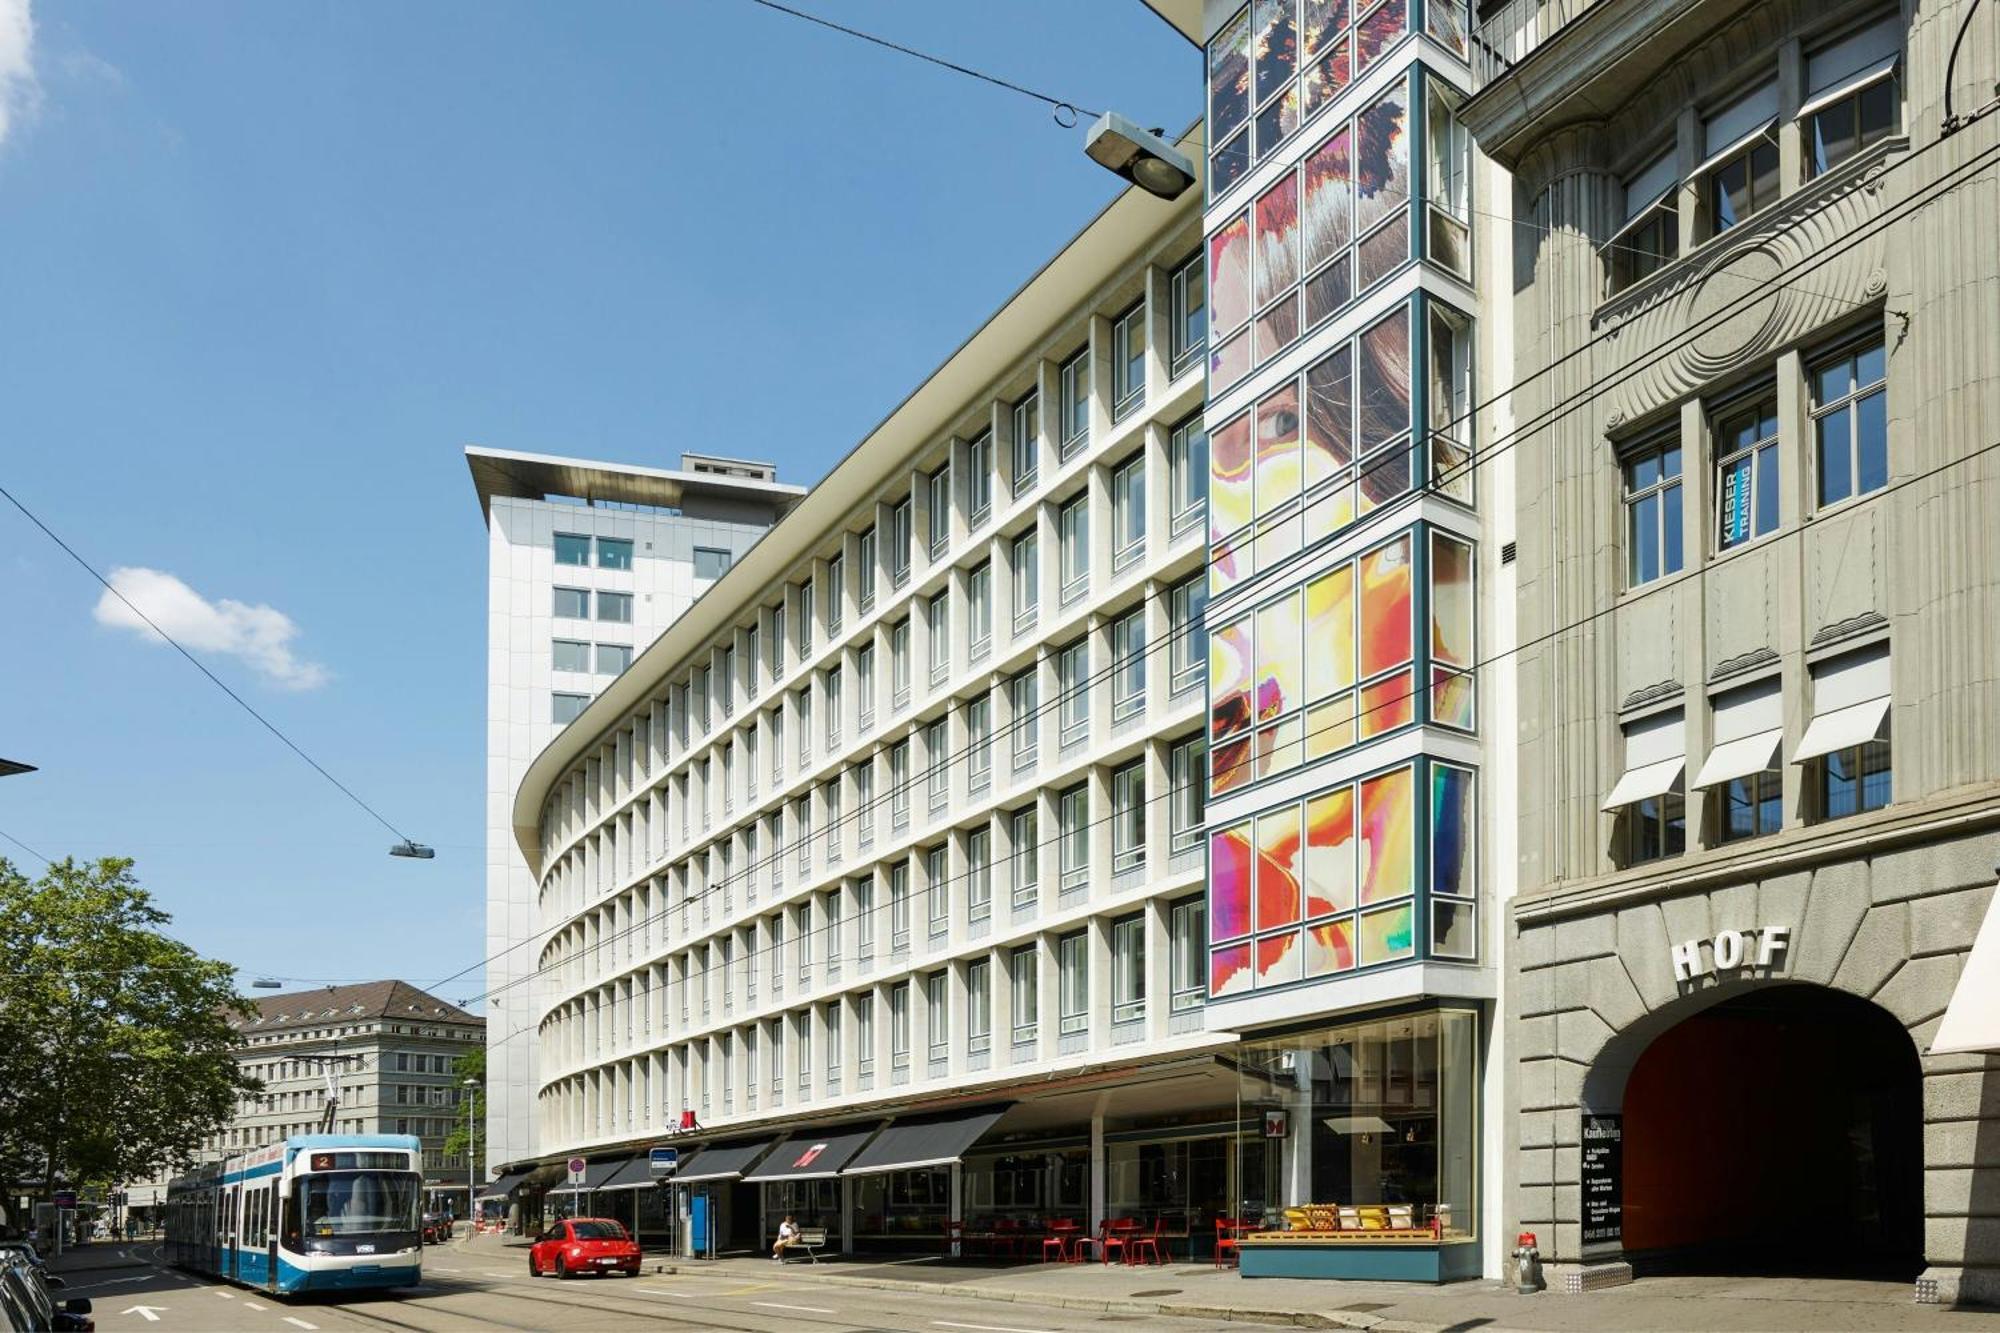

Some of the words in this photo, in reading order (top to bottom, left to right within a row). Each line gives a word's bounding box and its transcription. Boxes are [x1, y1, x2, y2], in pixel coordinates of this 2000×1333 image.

[1724, 473, 1737, 544] KIESER
[1740, 466, 1751, 537] TRAINING
[1671, 926, 1791, 982] HOF
[319, 1156, 329, 1168] 2
